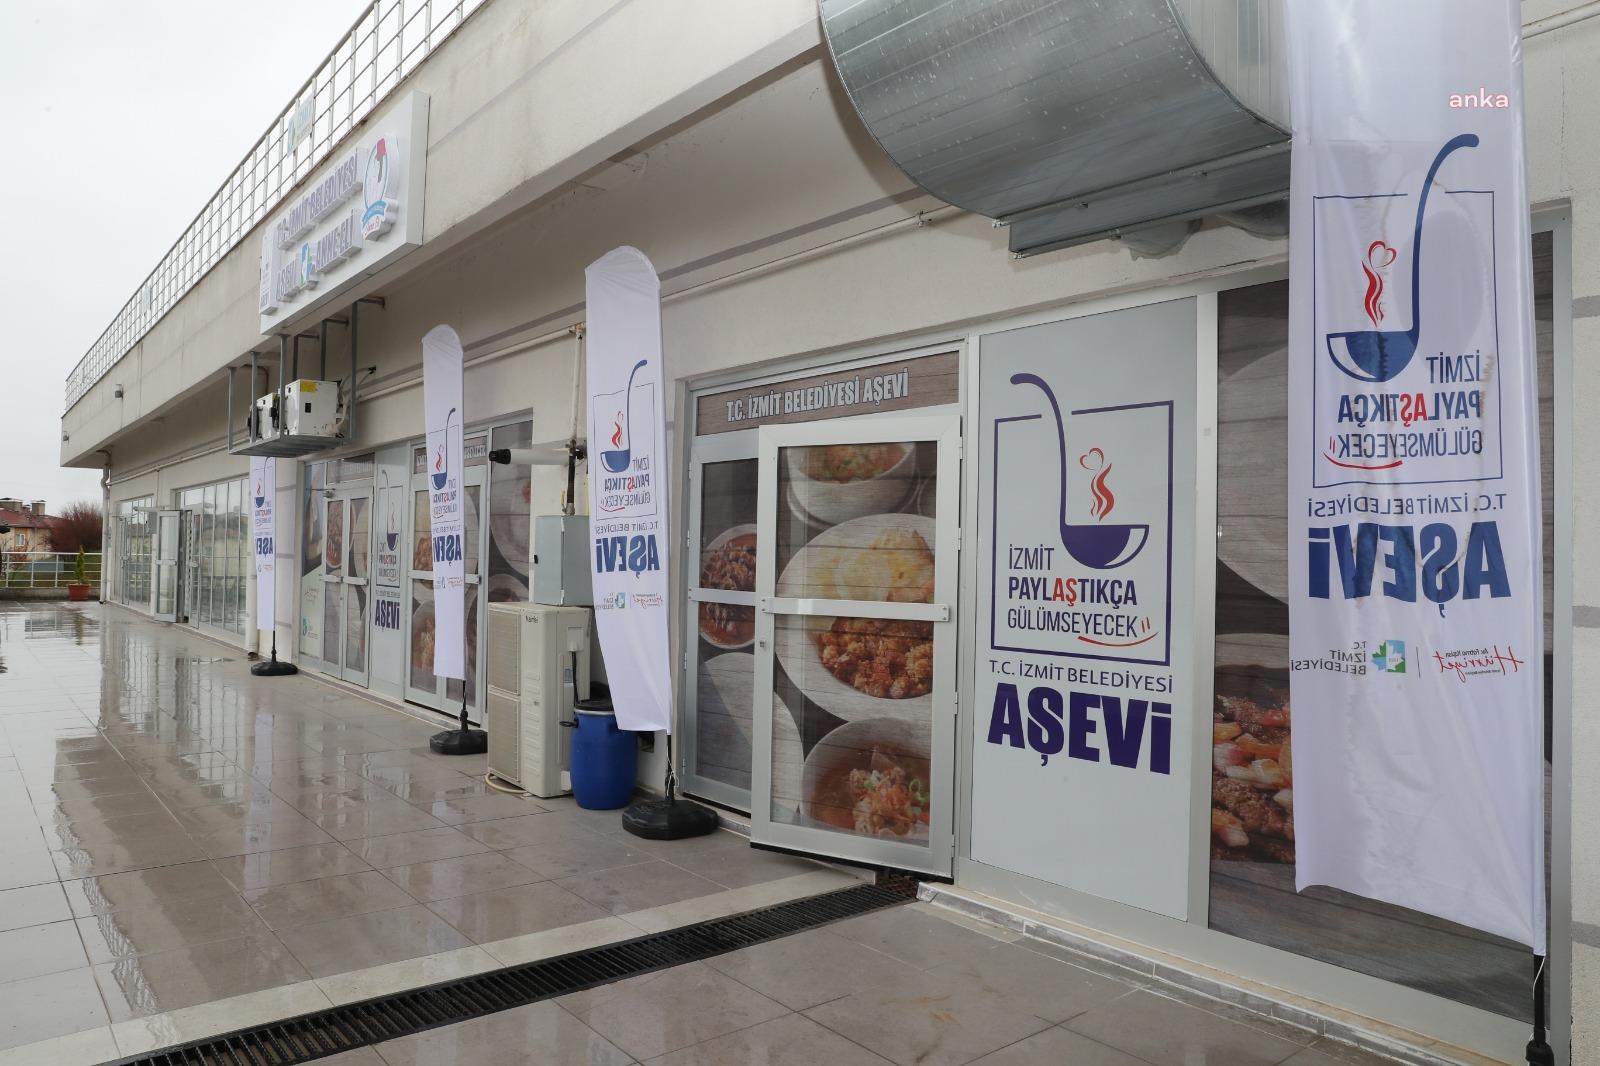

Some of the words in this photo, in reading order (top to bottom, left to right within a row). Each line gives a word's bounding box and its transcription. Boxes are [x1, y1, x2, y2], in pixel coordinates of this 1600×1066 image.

[726, 399, 746, 422] T.C.
[748, 390, 782, 419] İZMİT
[784, 375, 860, 414] BELEDİYESİ
[863, 367, 909, 406] AŞEVİ
[1009, 543, 1055, 570] İZMİT
[1008, 576, 1137, 610] PAYLAŞTIKÇA
[1007, 605, 1138, 638] GÜLÜMSEYECEK
[989, 659, 1015, 676] T.C.
[1019, 660, 1064, 681] İZMİT
[1067, 667, 1173, 693] BELEDİYESİ
[987, 682, 1172, 776] AŞEVİ
